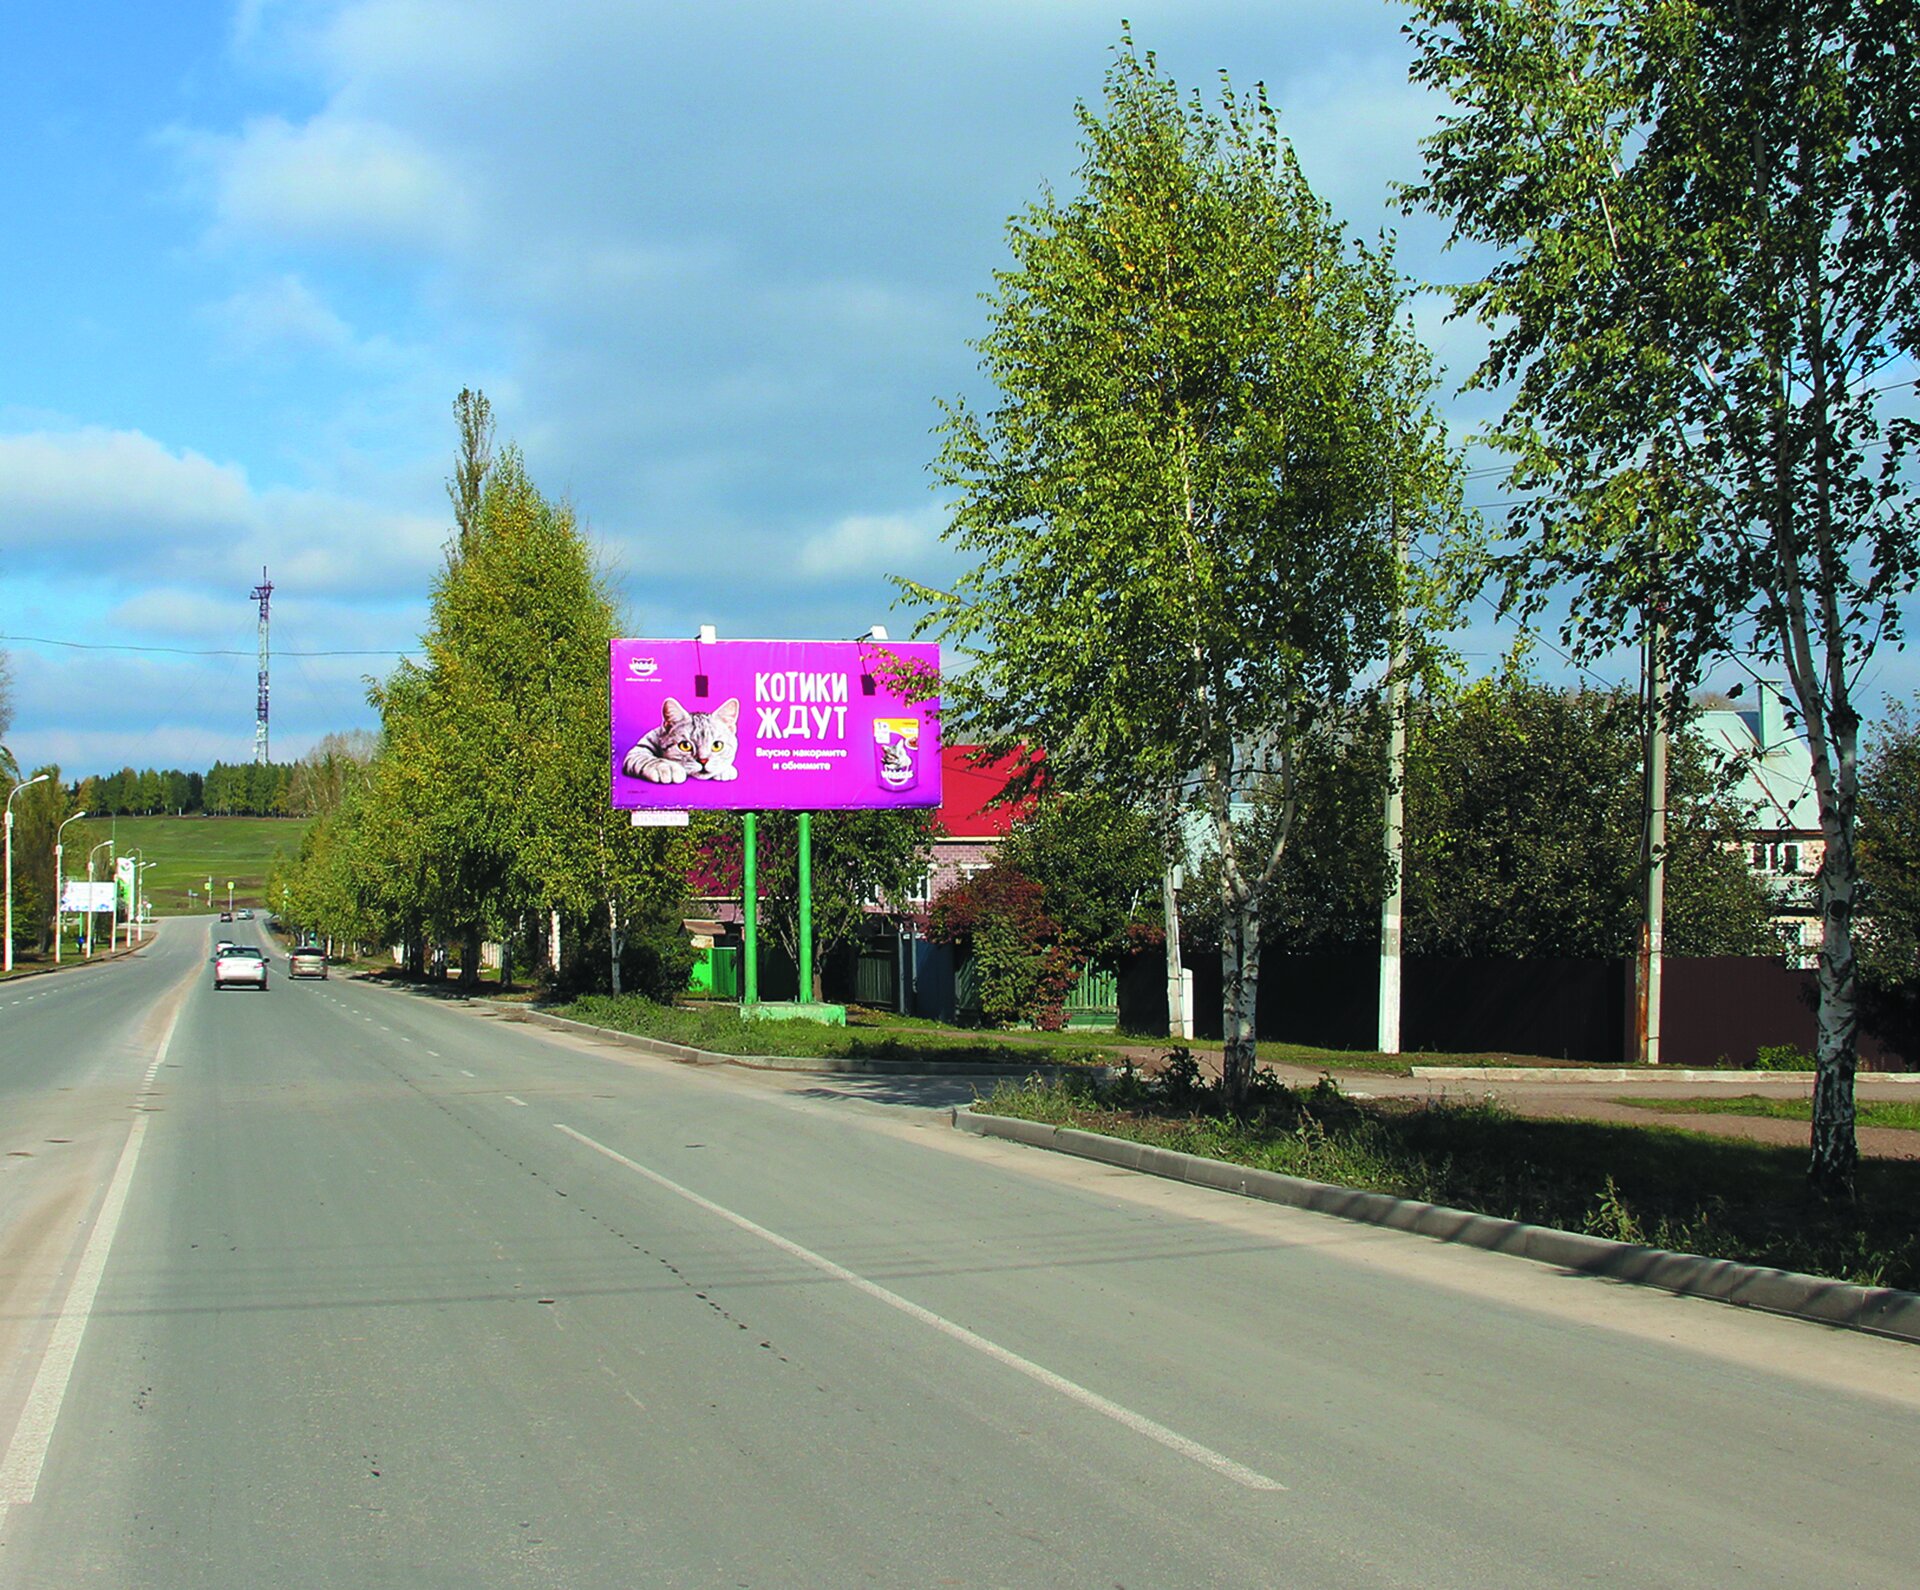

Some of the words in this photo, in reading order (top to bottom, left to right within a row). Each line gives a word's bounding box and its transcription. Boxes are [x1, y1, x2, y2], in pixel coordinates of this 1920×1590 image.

[755, 672, 848, 703] КОТИКИ
[755, 705, 848, 740] ЖДУТ
[756, 747, 791, 759] Вкусно
[792, 748, 848, 759] накормите
[772, 762, 780, 770] и
[781, 761, 831, 770] обнимите
